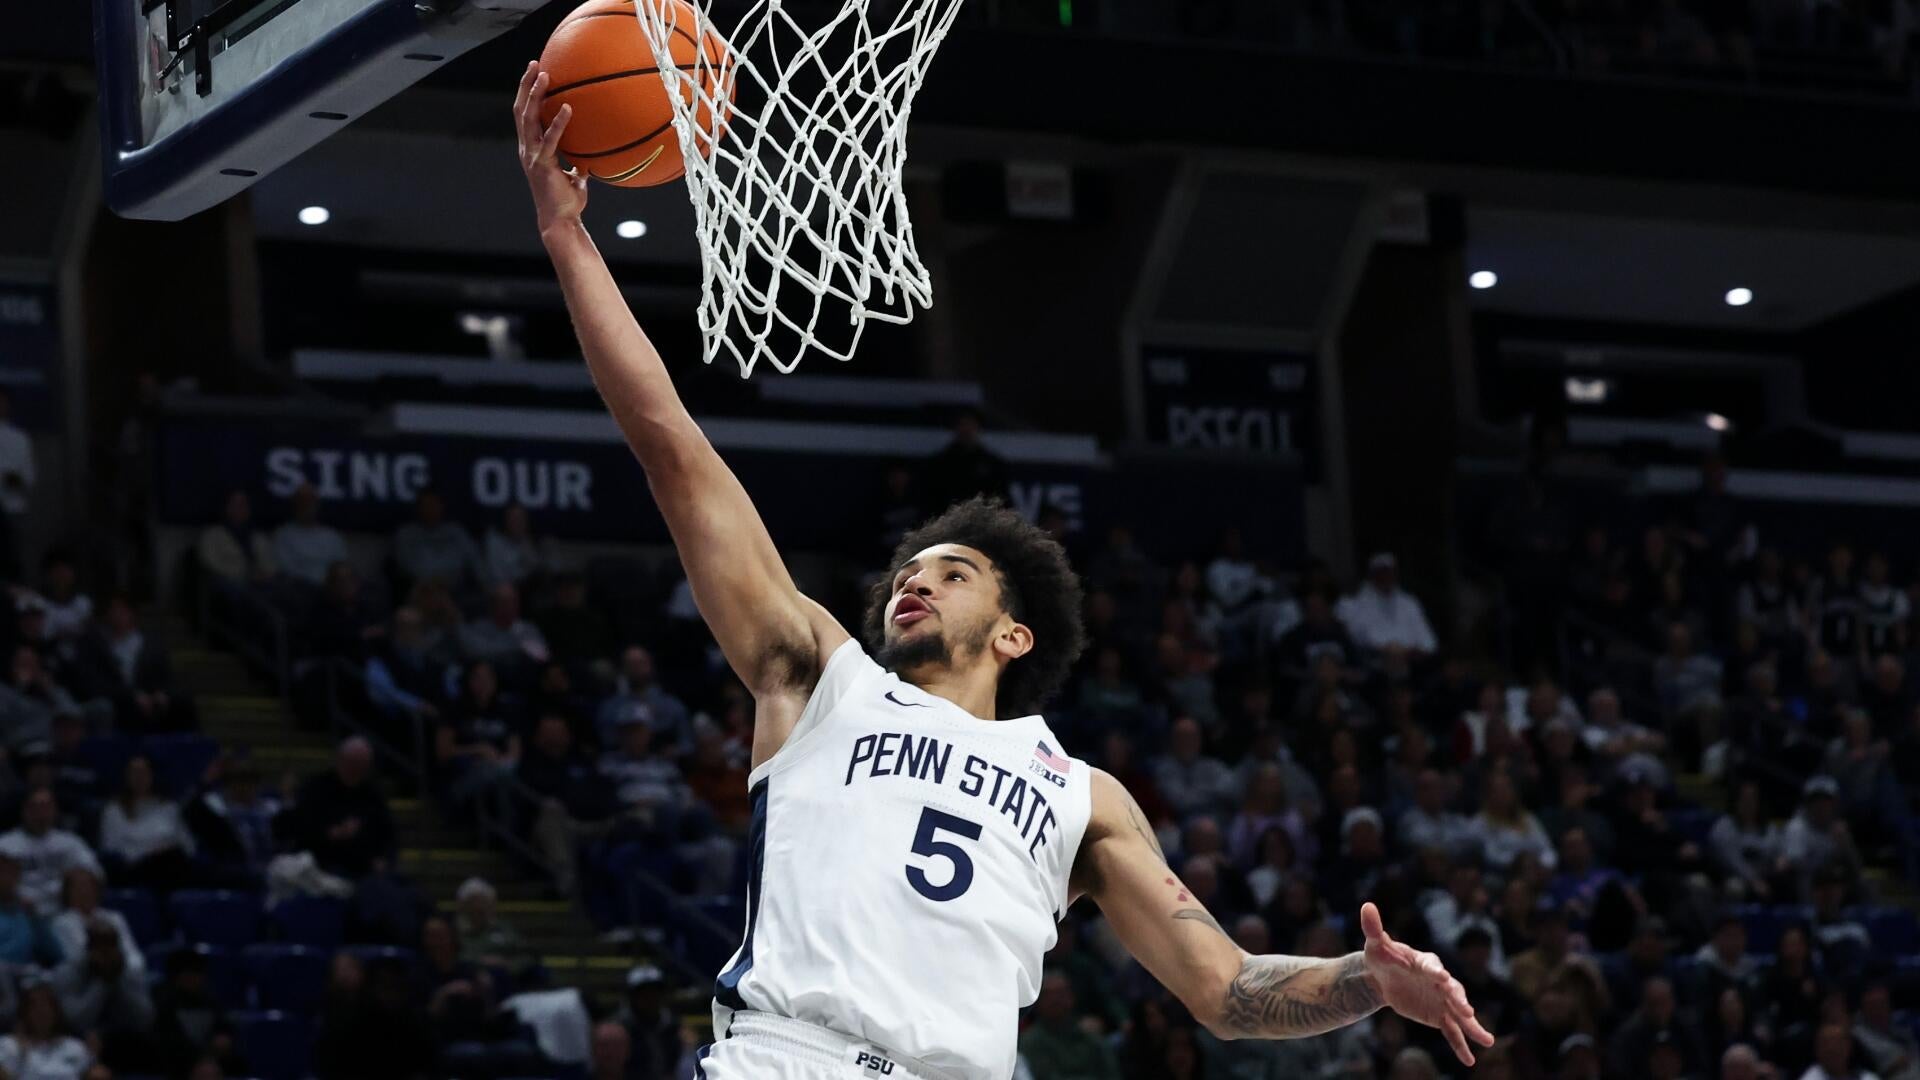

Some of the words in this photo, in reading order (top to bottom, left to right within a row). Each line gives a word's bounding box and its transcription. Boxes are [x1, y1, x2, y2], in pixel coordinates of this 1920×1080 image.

[266, 449, 431, 502] SING
[472, 457, 593, 511] OUR
[844, 731, 953, 786] PENN
[959, 755, 1056, 864] STATE
[905, 806, 982, 902] 5
[855, 1050, 895, 1076] PSU
